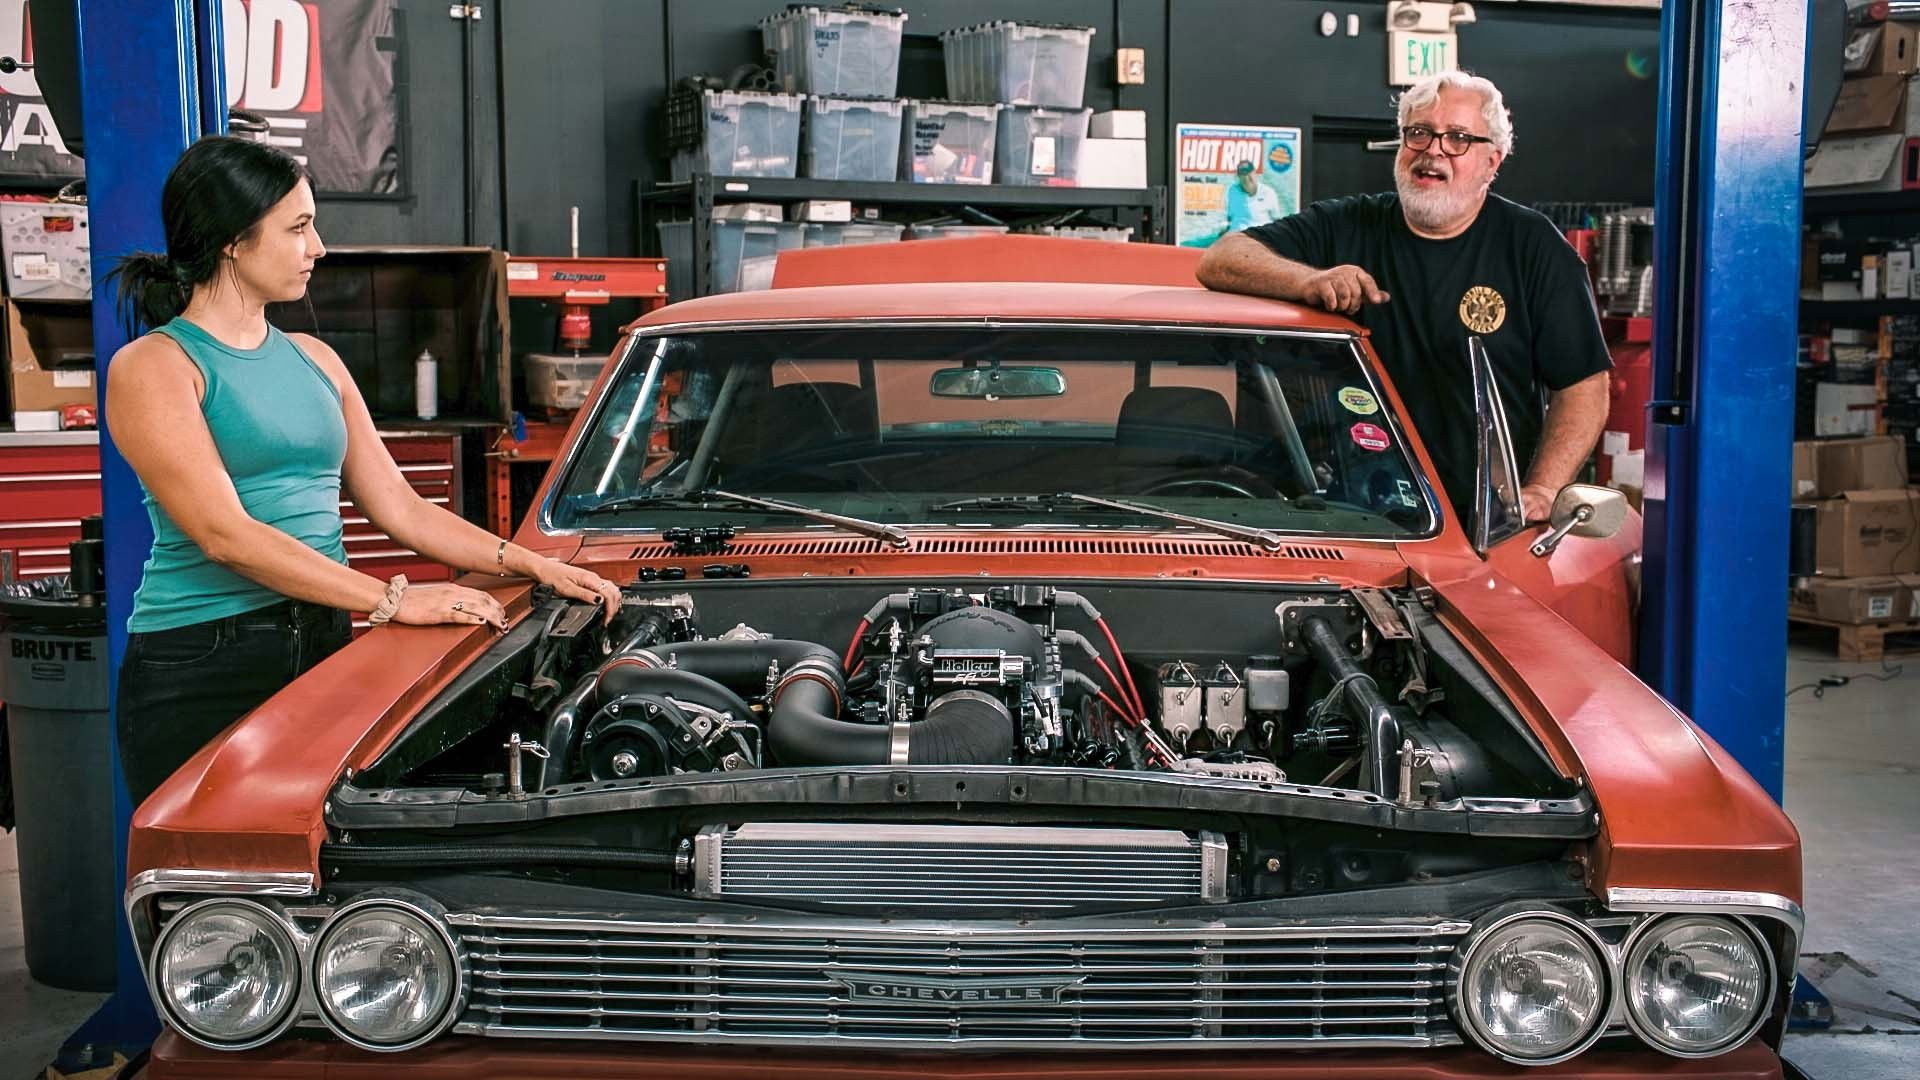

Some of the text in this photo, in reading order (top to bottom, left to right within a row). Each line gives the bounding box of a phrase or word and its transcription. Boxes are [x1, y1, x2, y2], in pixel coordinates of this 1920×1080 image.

[1407, 39, 1447, 76] EXIT
[1181, 138, 1222, 171] HOT
[1220, 139, 1262, 173] ROD
[11, 638, 95, 661] BRUTE
[941, 659, 994, 678] Holley
[867, 984, 1043, 1001] CHEVELLE
